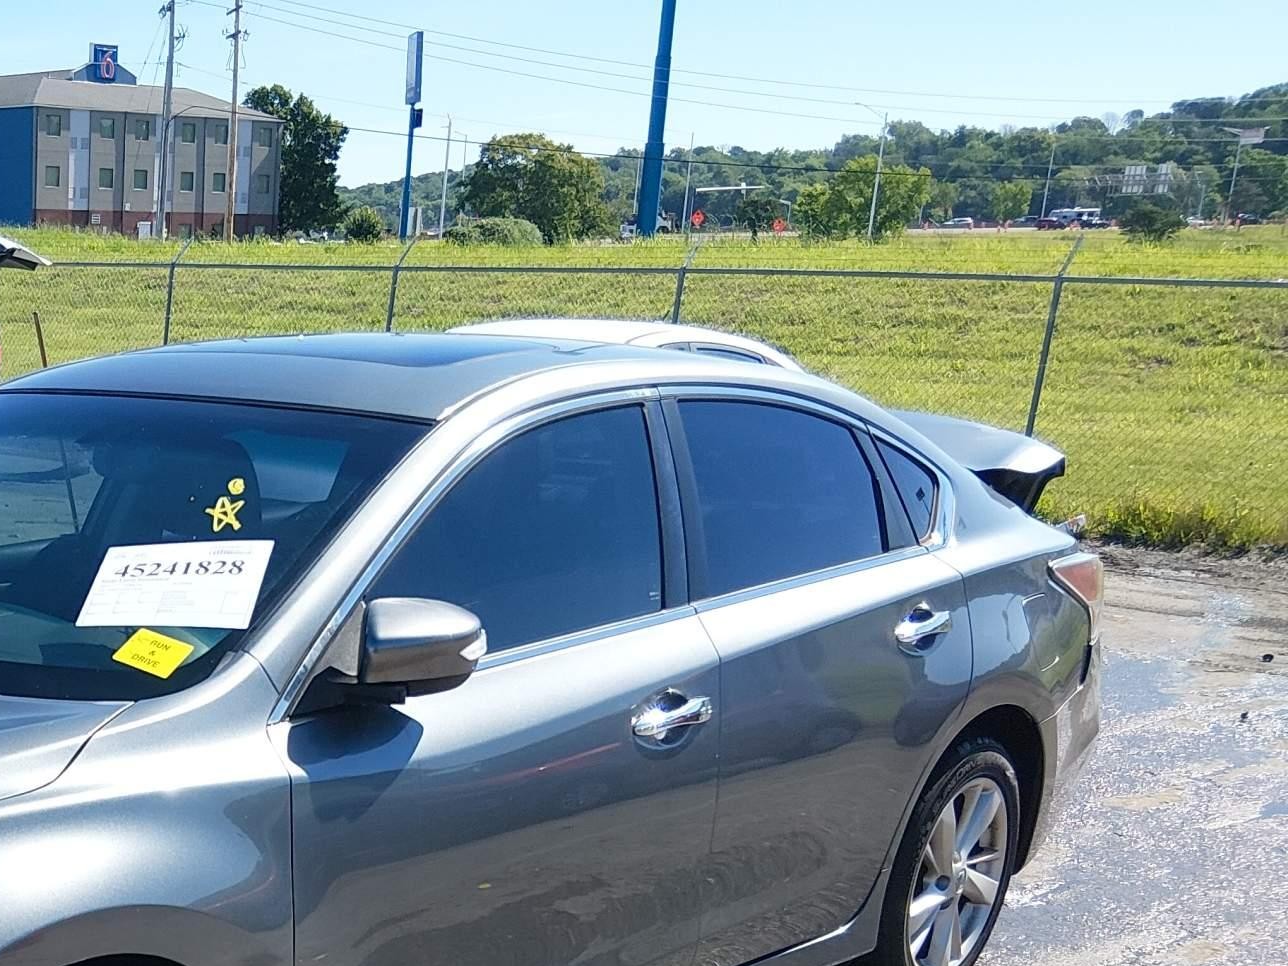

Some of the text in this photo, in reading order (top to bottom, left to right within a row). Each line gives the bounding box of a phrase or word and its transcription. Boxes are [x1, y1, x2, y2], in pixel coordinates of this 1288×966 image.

[101, 50, 115, 79] 6
[114, 560, 245, 578] 45241828
[150, 639, 171, 652] RUN
[131, 653, 161, 668] DRIVE
